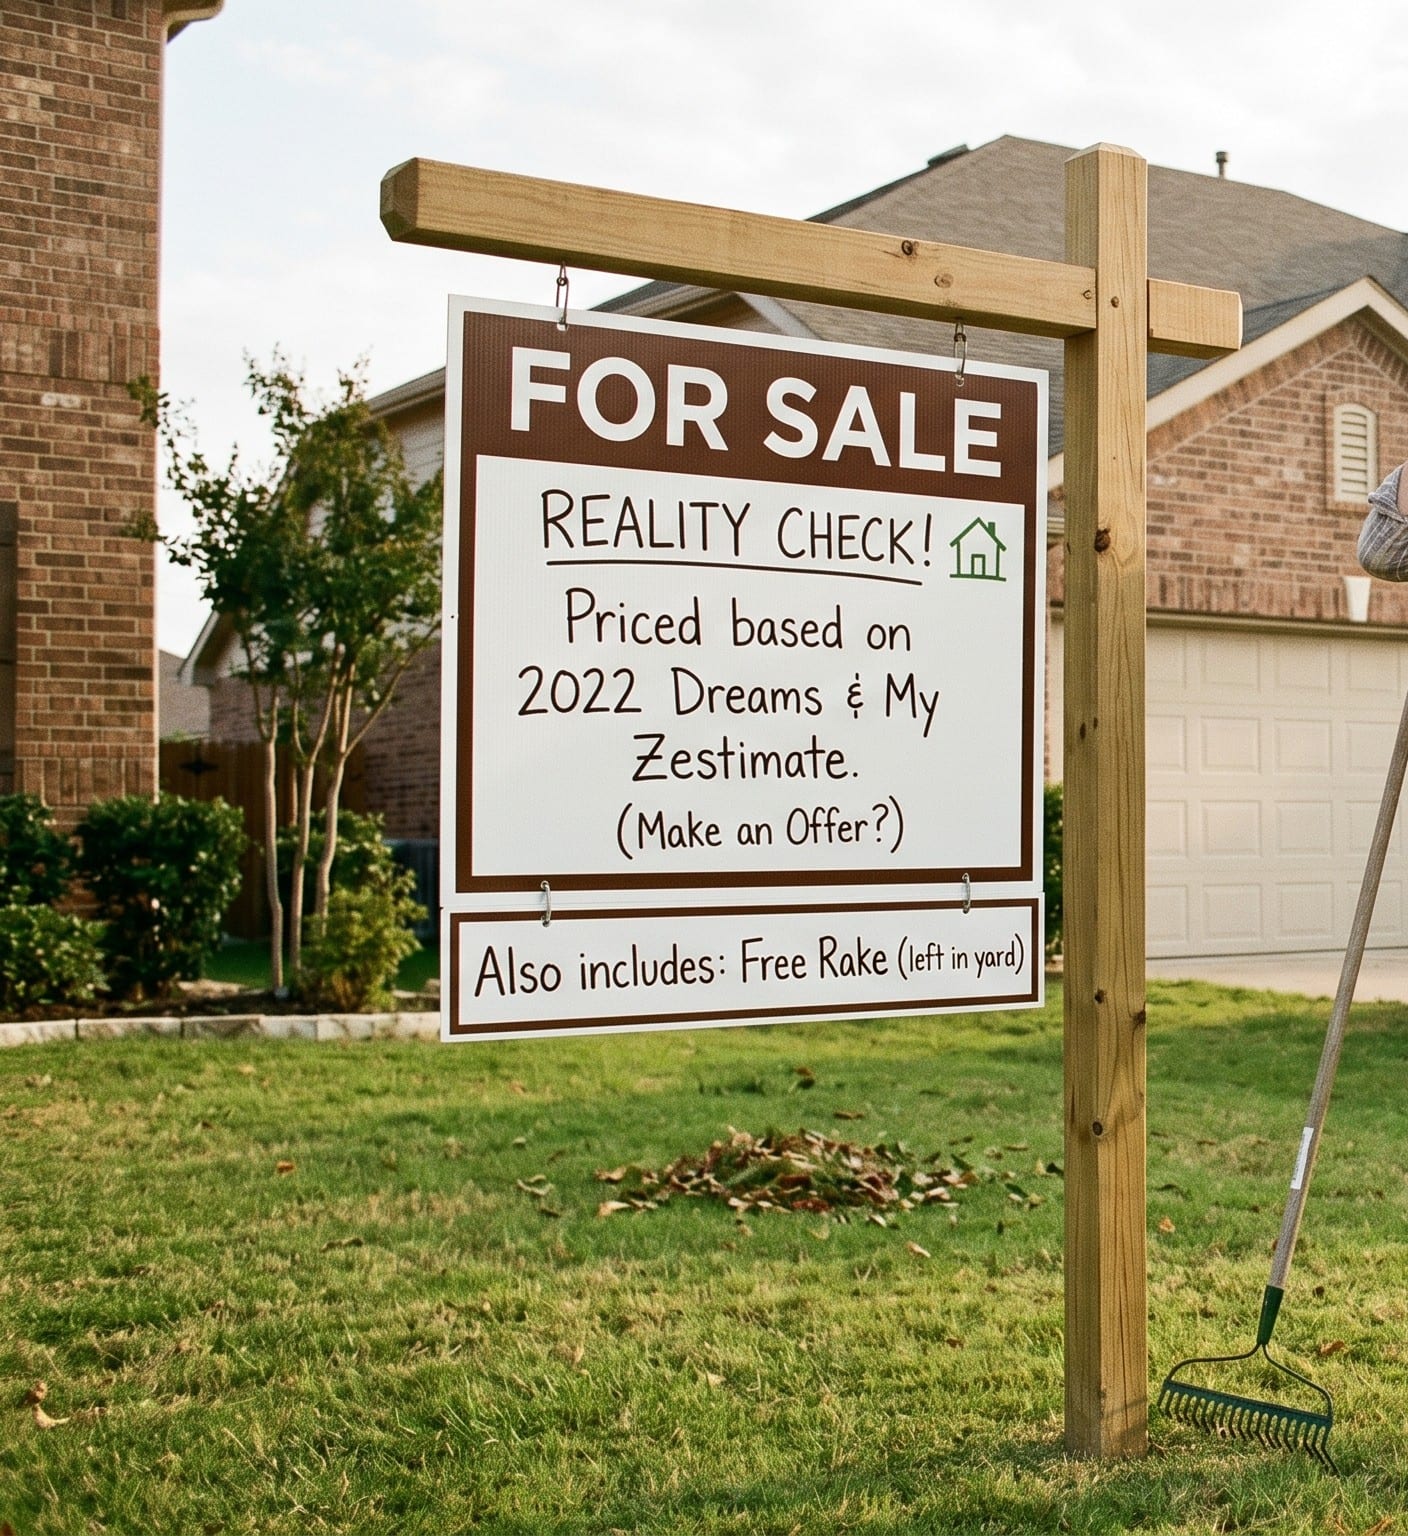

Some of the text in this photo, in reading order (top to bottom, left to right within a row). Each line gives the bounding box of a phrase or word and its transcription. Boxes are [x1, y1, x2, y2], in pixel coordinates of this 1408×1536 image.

[510, 346, 1002, 478] FOR SALE
[540, 488, 933, 567] REALITY CHECK!
[565, 587, 912, 652] Priced based on
[517, 665, 941, 738] 2022 Dreams & My
[631, 733, 859, 782] Zestimate.
[616, 795, 905, 860] (Make an Offer?)
[474, 933, 1026, 998] Also includes: Free Rake (left in yard)
